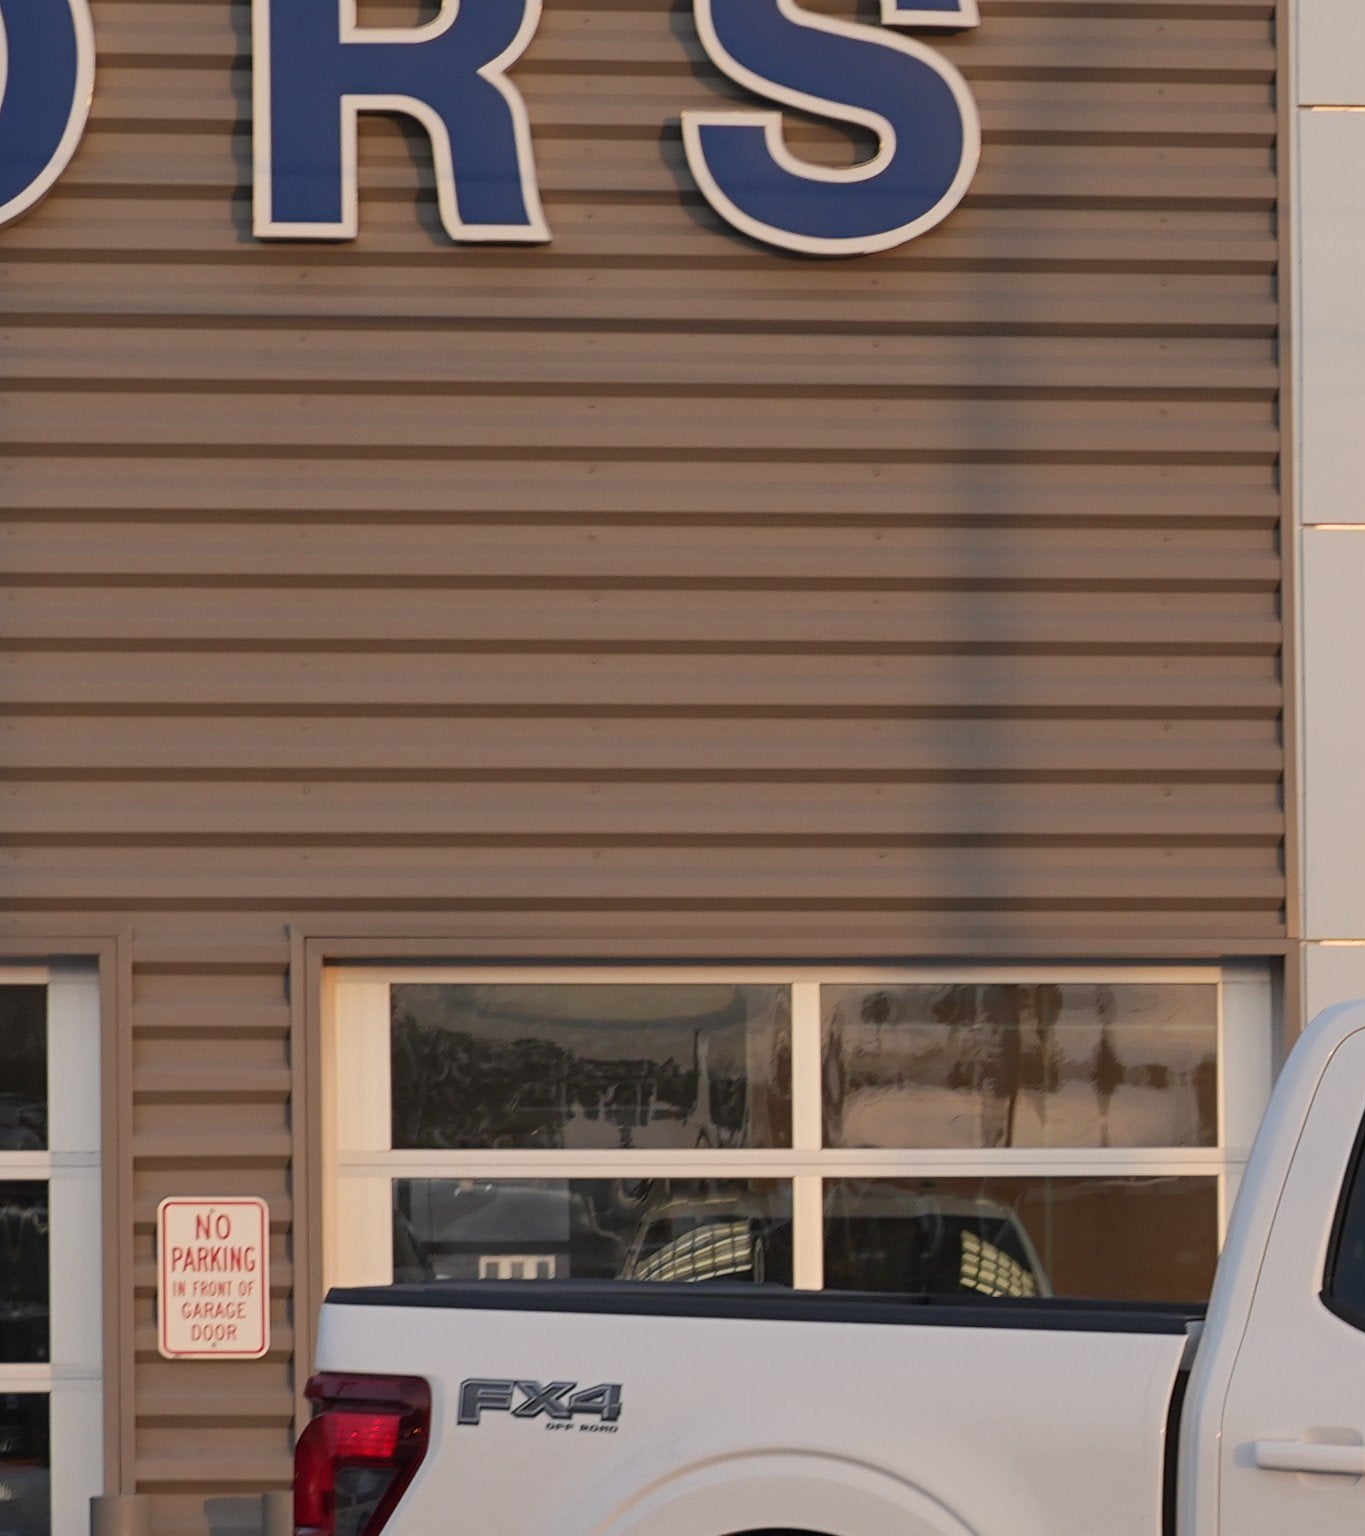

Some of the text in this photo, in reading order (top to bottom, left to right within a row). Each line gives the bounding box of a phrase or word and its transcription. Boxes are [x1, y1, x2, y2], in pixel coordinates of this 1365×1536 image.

[195, 1214, 231, 1240] NO
[171, 1247, 256, 1272] PARKING
[172, 1280, 255, 1297] IN FRONT OF
[181, 1301, 248, 1320] GARAGE
[191, 1324, 238, 1341] DOOR
[457, 1378, 623, 1426] FX4
[545, 1422, 619, 1433] OFF ROAD
